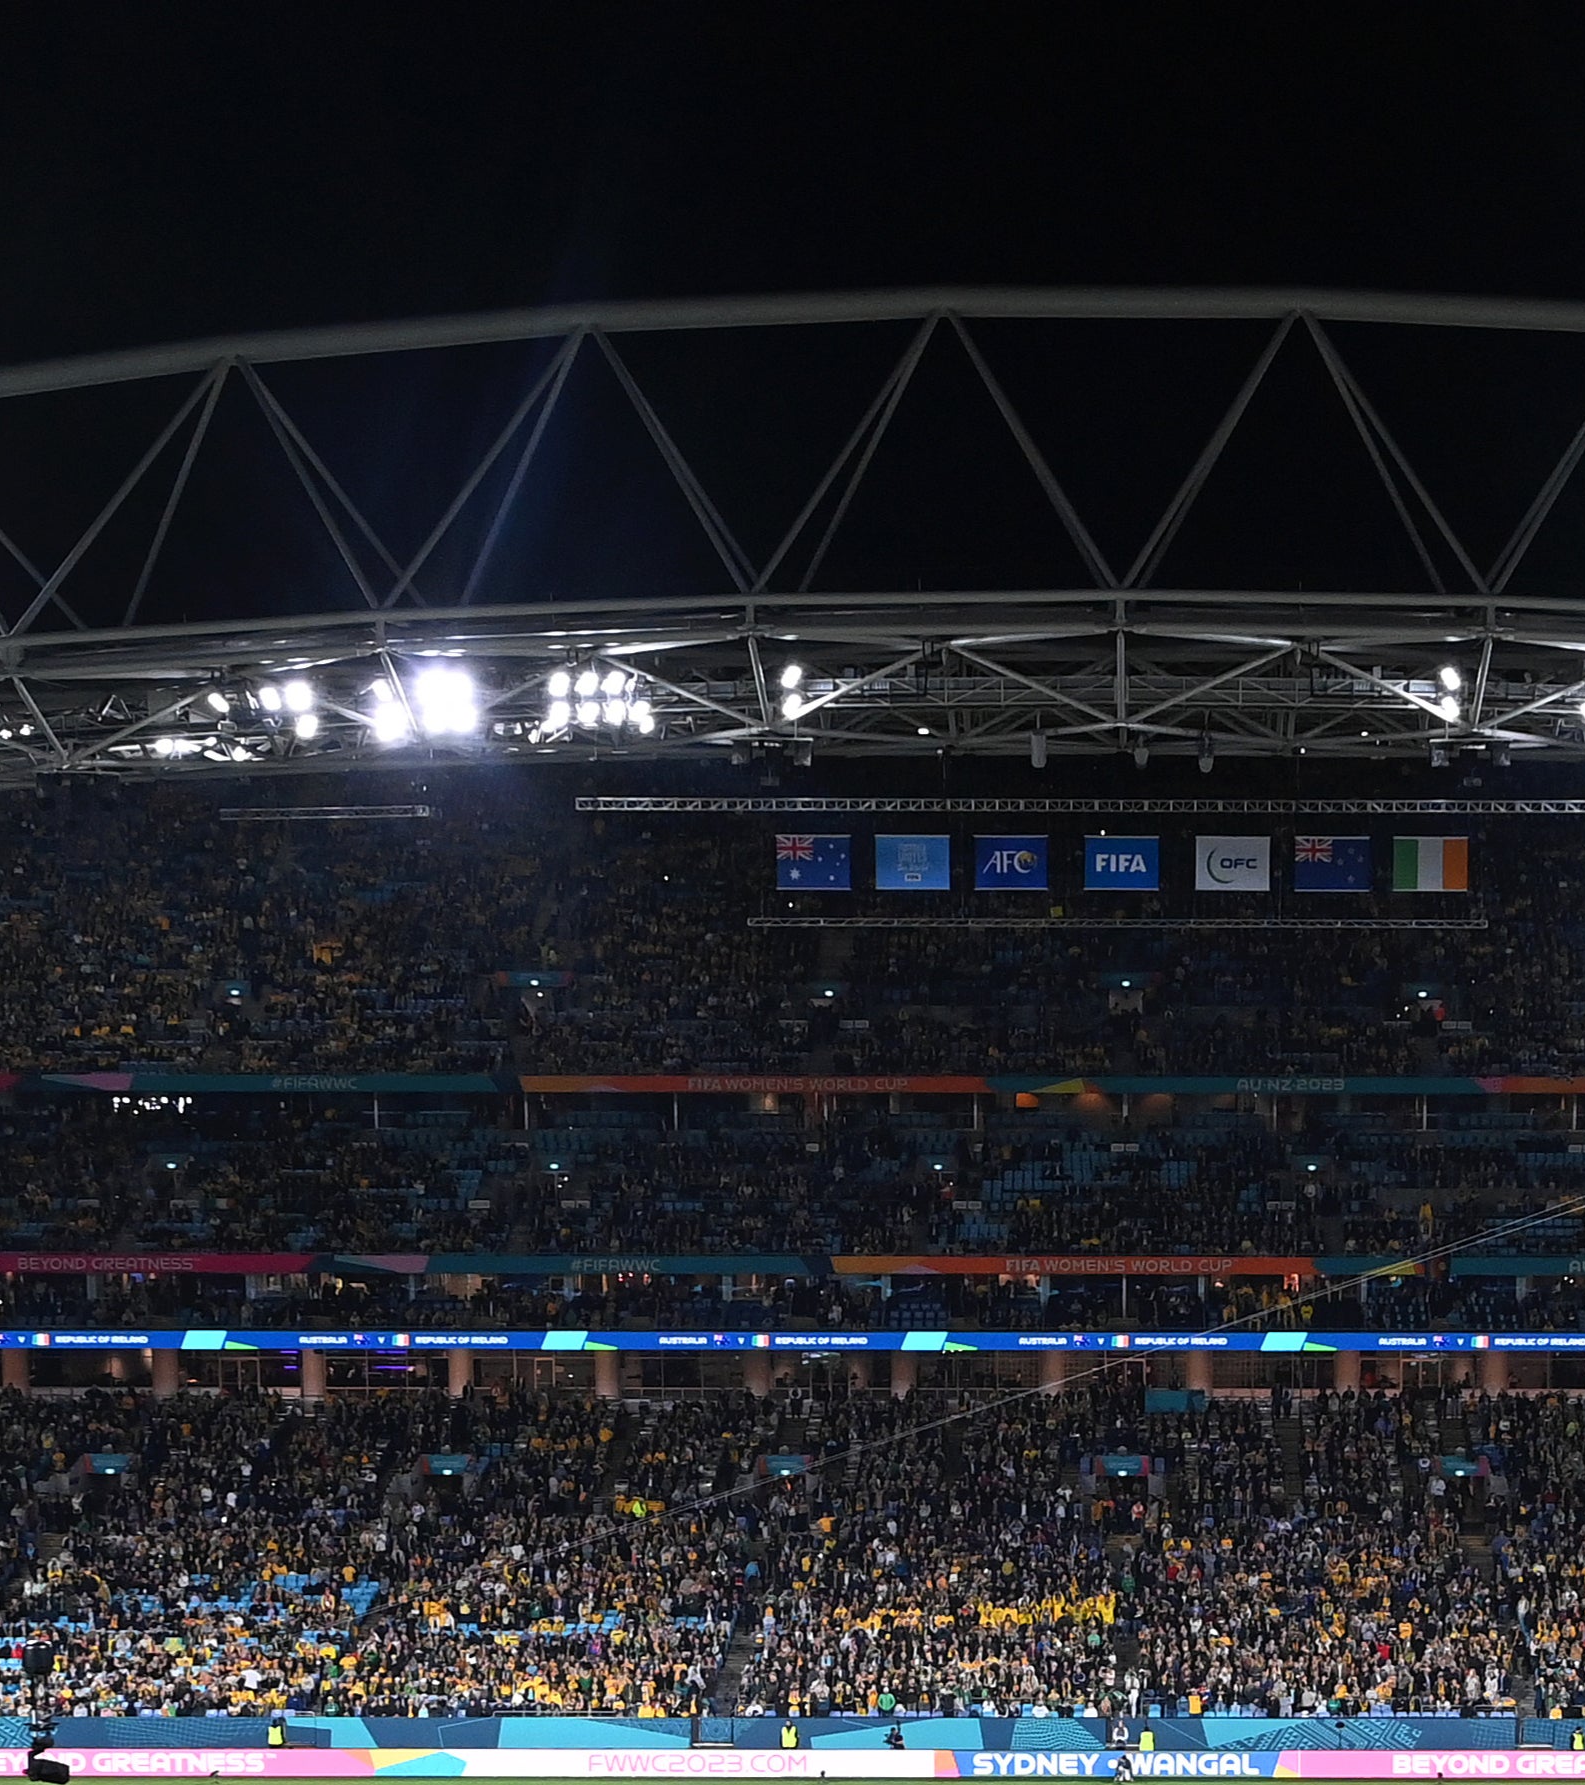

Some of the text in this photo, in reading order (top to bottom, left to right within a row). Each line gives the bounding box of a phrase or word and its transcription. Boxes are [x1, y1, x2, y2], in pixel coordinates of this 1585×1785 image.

[982, 850, 1037, 874] AFC
[1095, 853, 1148, 873] FIFA
[1220, 858, 1258, 869] OFC
[271, 1078, 359, 1090] #FIFAWWC
[688, 1077, 909, 1091] FIFA WOMEN'S WORLD CUP
[17, 1257, 87, 1271] BEYOND
[571, 1258, 661, 1272] #FIFAWWC
[1005, 1258, 1233, 1272] FIFA WOMEN'S WORLD CUP
[54, 1335, 97, 1344] REPUBLIC
[98, 1335, 110, 1344] OF
[111, 1335, 149, 1344] IRELAND
[298, 1336, 509, 1345] AUSTRALIA REPUBLIC OF IRELAND
[658, 1336, 868, 1345] AUSTRALIA REPUBLIC OF IRELAND
[1018, 1336, 1228, 1346] AUSTRALIA REPUBLIC OF IRELAND
[1378, 1337, 1427, 1346] AUSTRALIA
[1494, 1337, 1536, 1346] REPUBLIC
[1537, 1337, 1550, 1346] OF
[588, 1753, 807, 1774] FWWC2023.COM
[972, 1752, 1259, 1777] SYDNEY WANGAL
[1393, 1753, 1510, 1775] BEYOND
